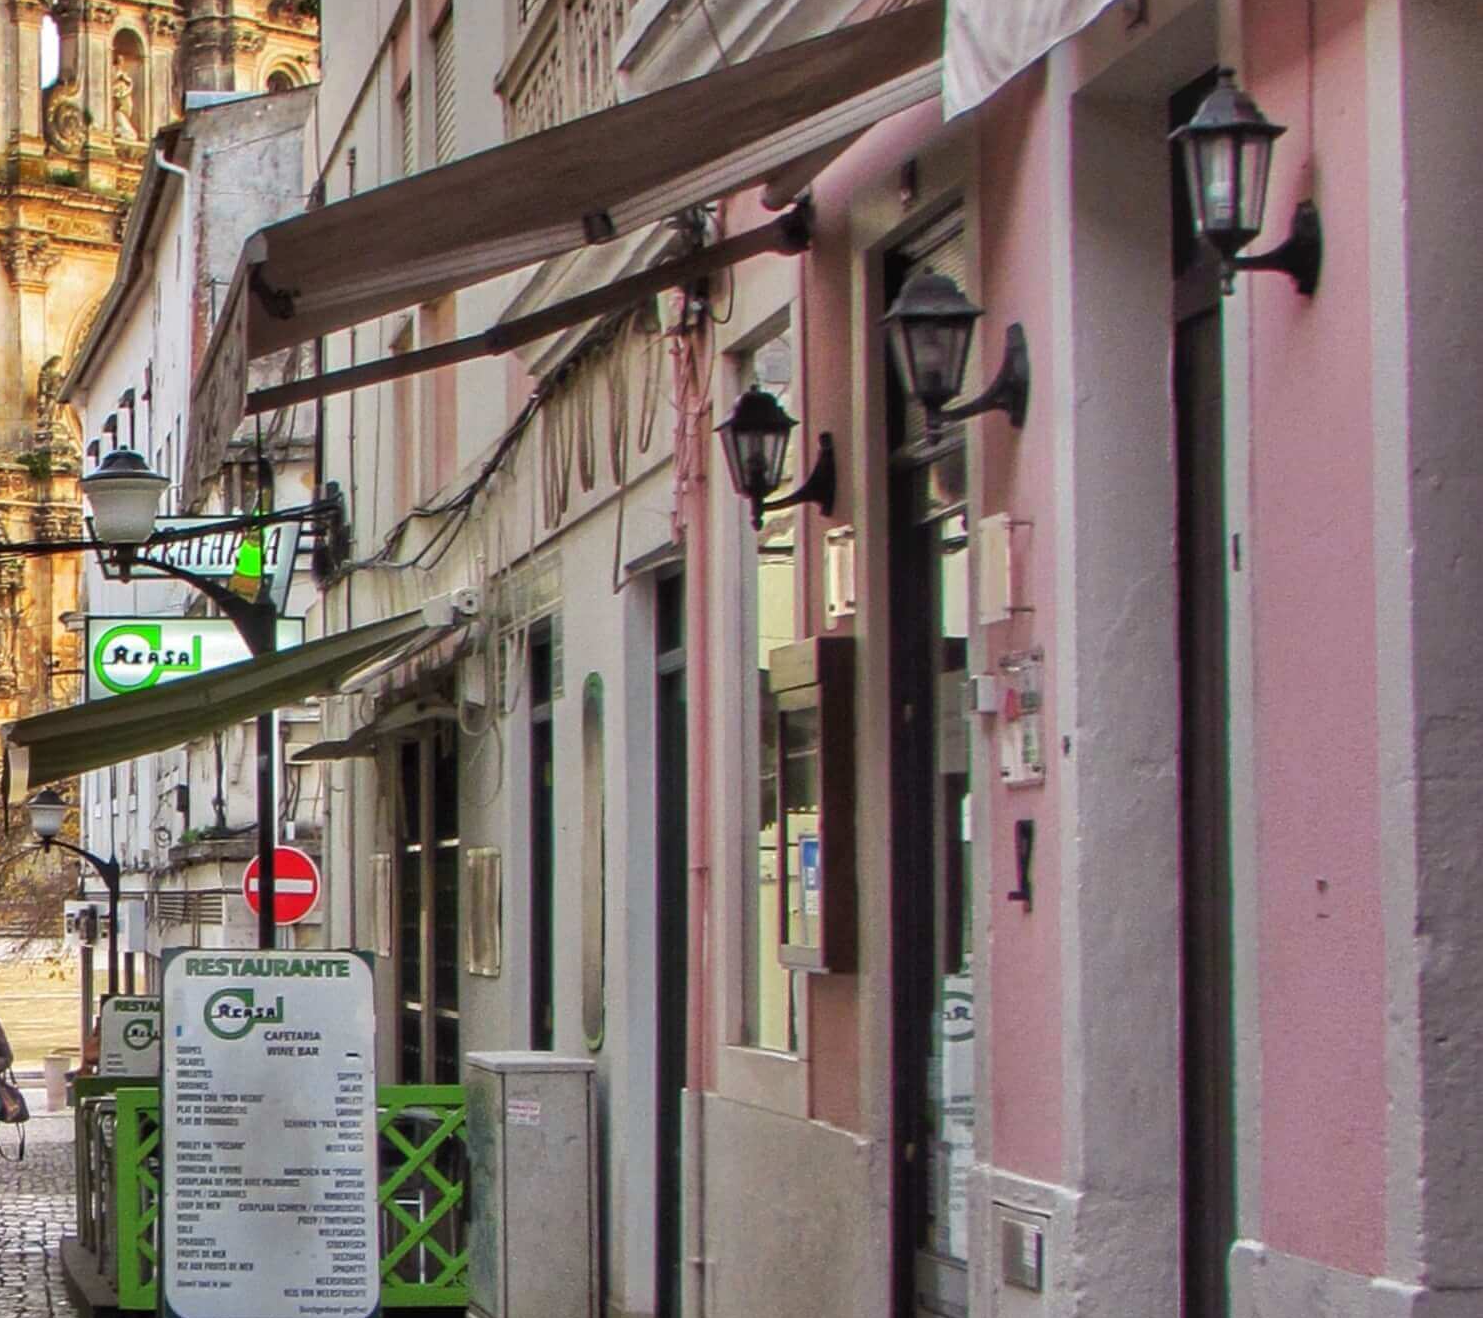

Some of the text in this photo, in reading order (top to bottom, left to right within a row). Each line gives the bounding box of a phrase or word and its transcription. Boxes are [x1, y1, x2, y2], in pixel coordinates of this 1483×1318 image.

[184, 958, 350, 978] RESTAURANTE
[267, 1046, 320, 1057] WINE BAR
